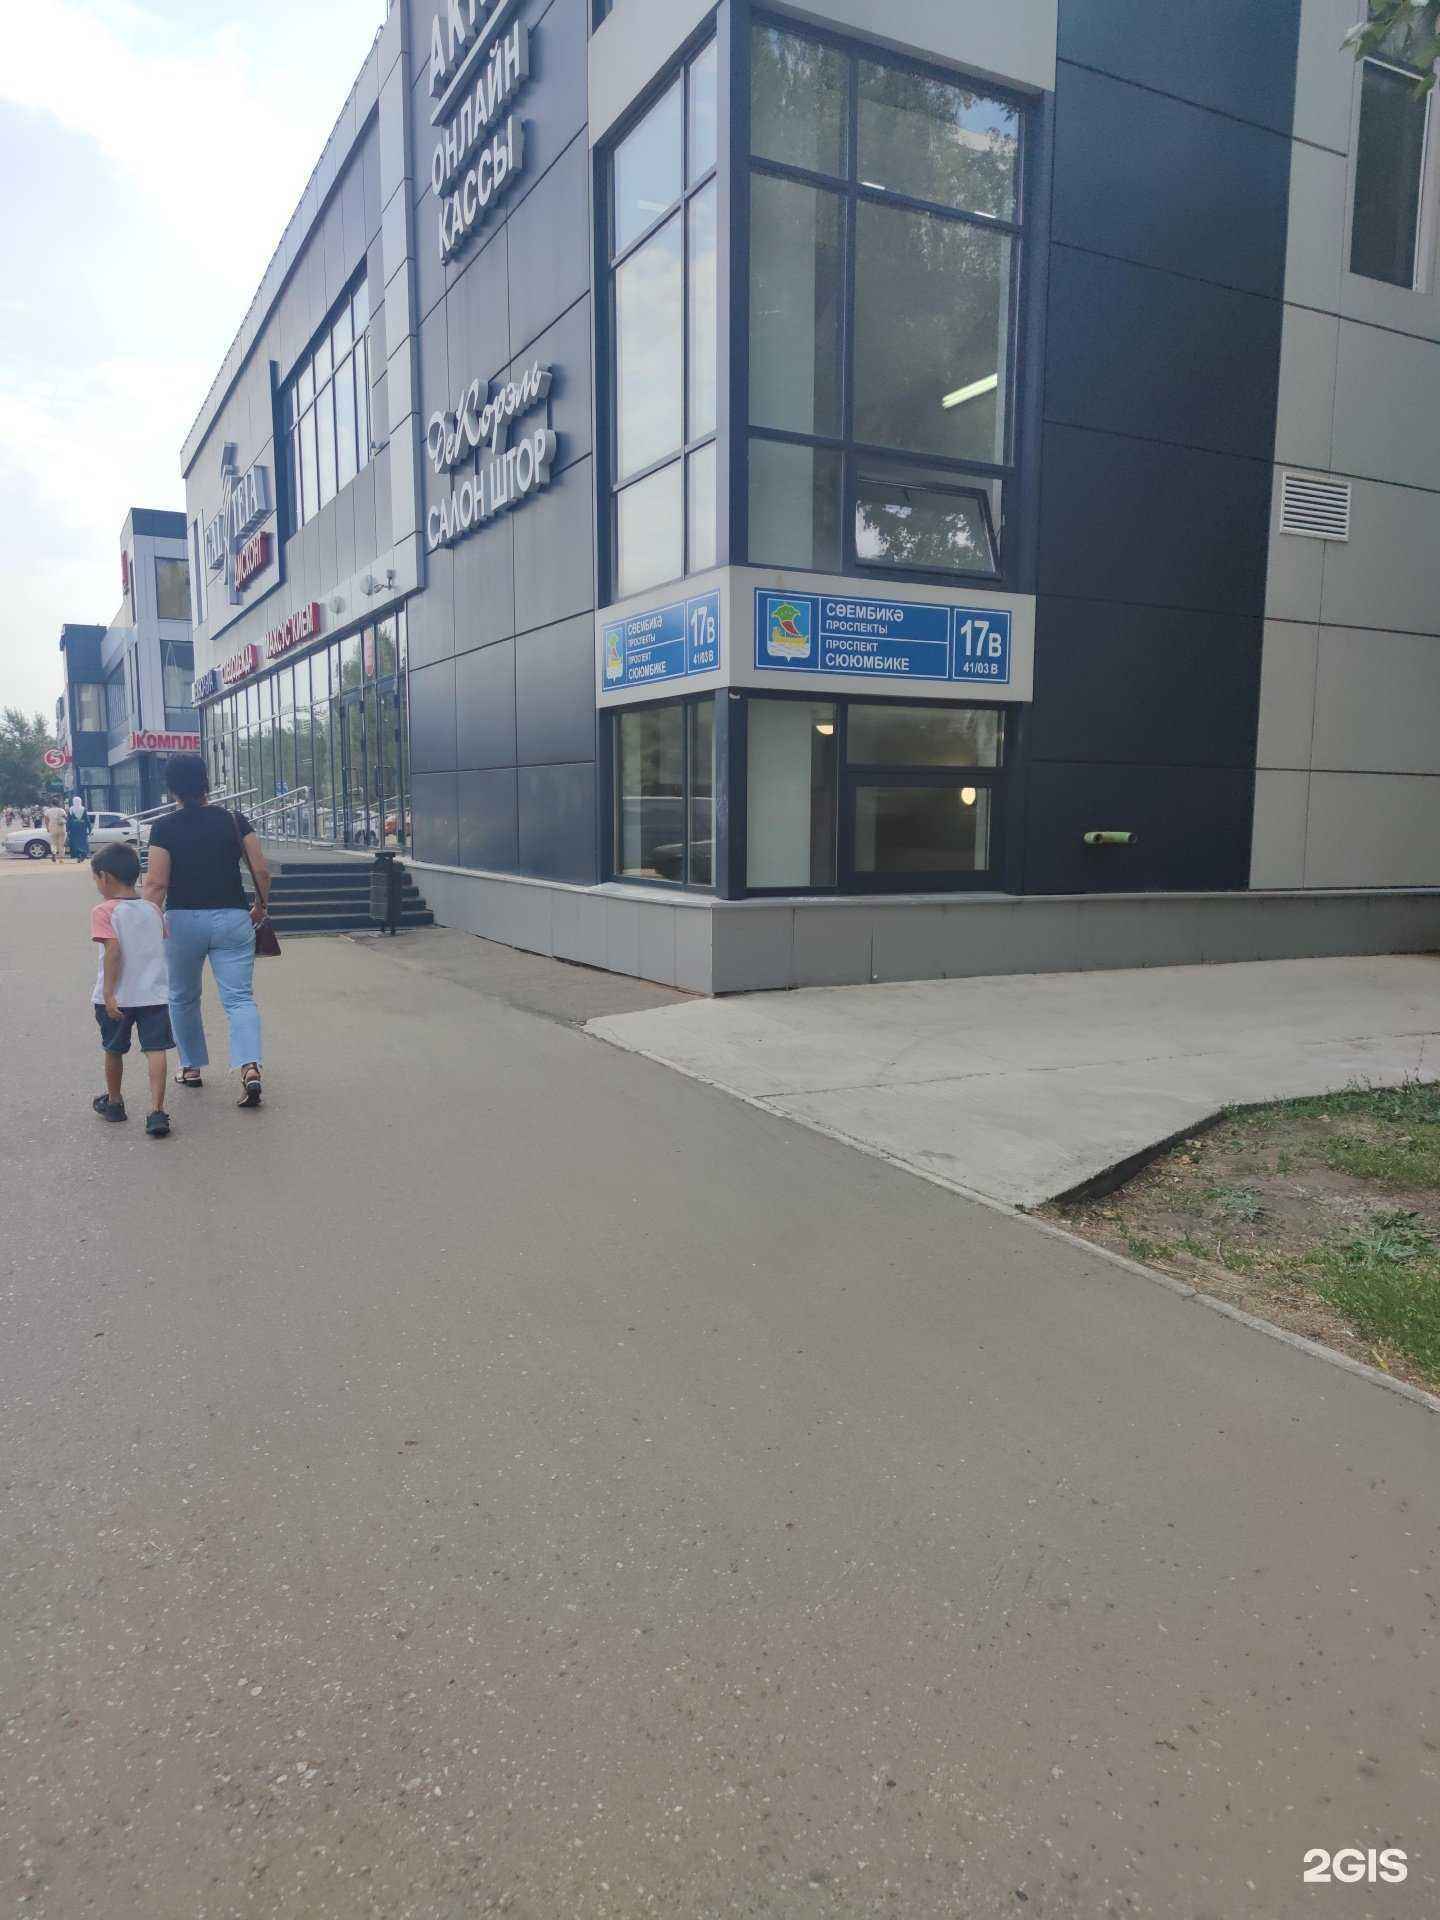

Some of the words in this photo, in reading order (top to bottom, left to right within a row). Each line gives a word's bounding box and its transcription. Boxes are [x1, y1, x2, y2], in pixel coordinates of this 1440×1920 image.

[432, 19, 521, 197] ОНЛАЙН
[439, 114, 515, 260] КАССЫ
[428, 470, 485, 548] САЛОН
[490, 428, 547, 509] ШТОР
[827, 602, 904, 622] СӨЕМБИКӘ
[826, 620, 888, 634] ПРОСПЕКТЫ
[826, 640, 879, 652] ПРОСПЕКТ
[628, 661, 667, 680] СЮЮМБИКЕ
[825, 653, 910, 671] СЮЮМБИКЕ
